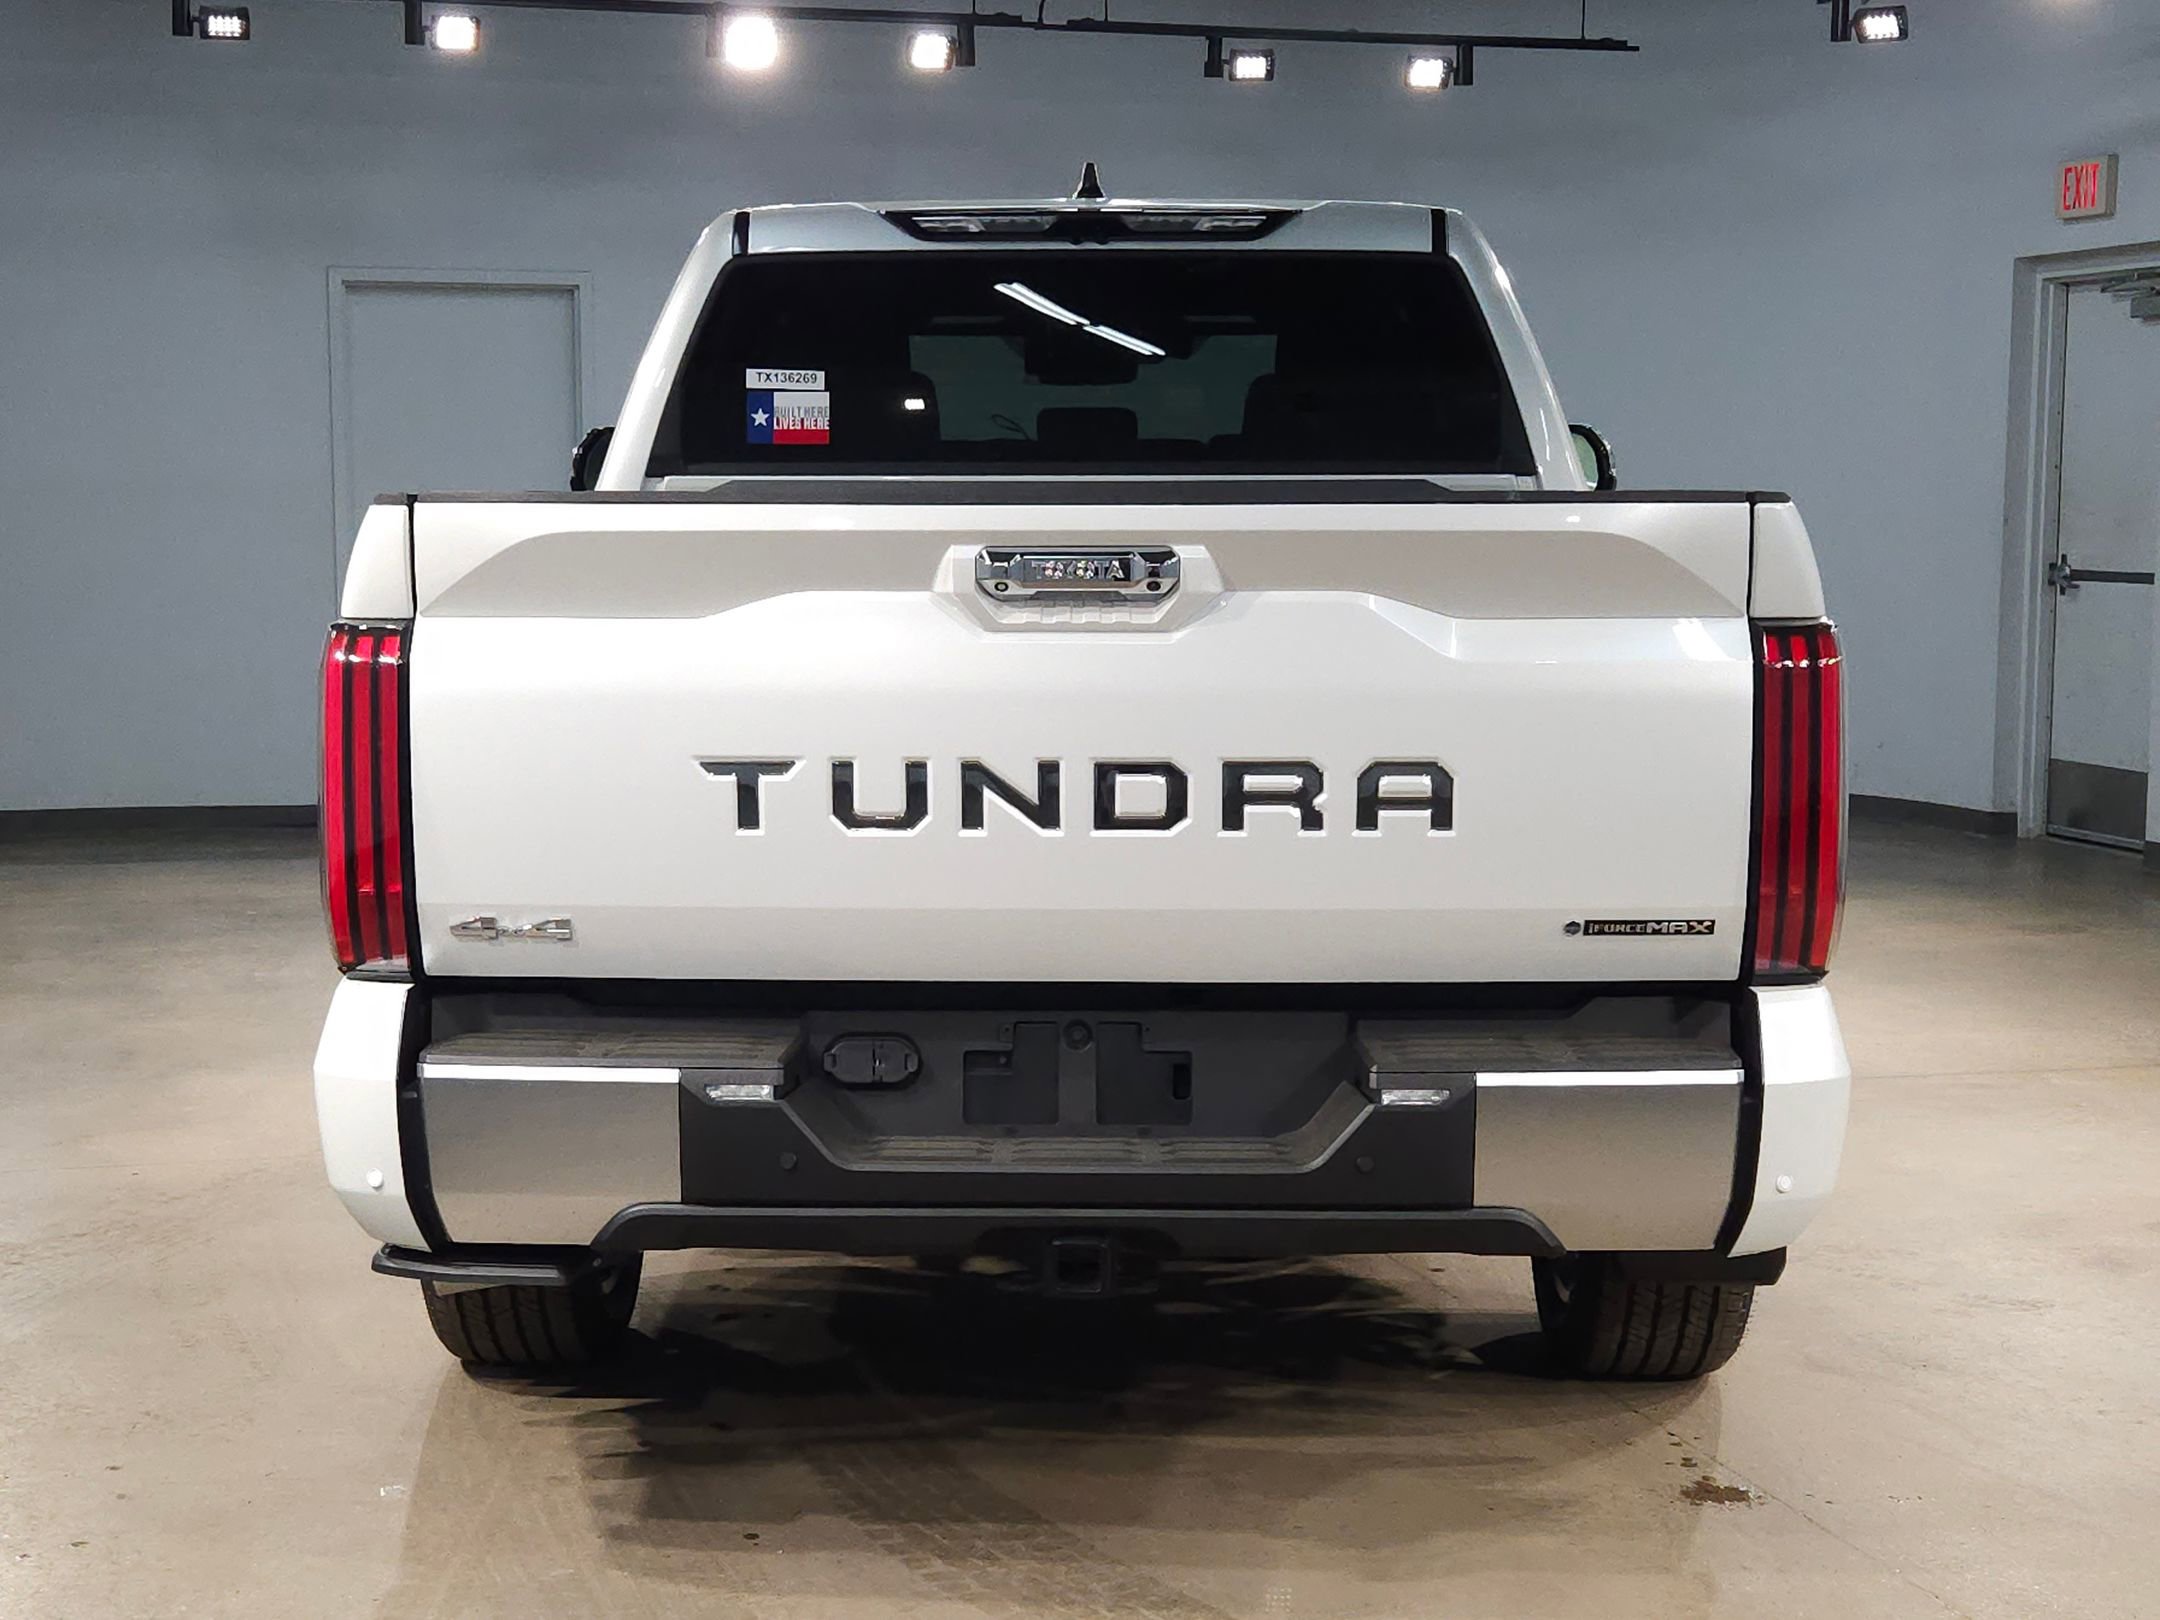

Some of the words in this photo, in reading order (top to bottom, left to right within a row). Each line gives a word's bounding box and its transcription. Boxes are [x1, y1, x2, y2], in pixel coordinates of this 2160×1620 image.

[2063, 162, 2101, 211] EXIT
[756, 371, 818, 384] TX136269
[774, 406, 801, 418] BUILT
[804, 406, 829, 418] HERE
[773, 417, 801, 430] LIVES
[804, 418, 830, 430] HERE
[692, 757, 1456, 837] TUNDRA
